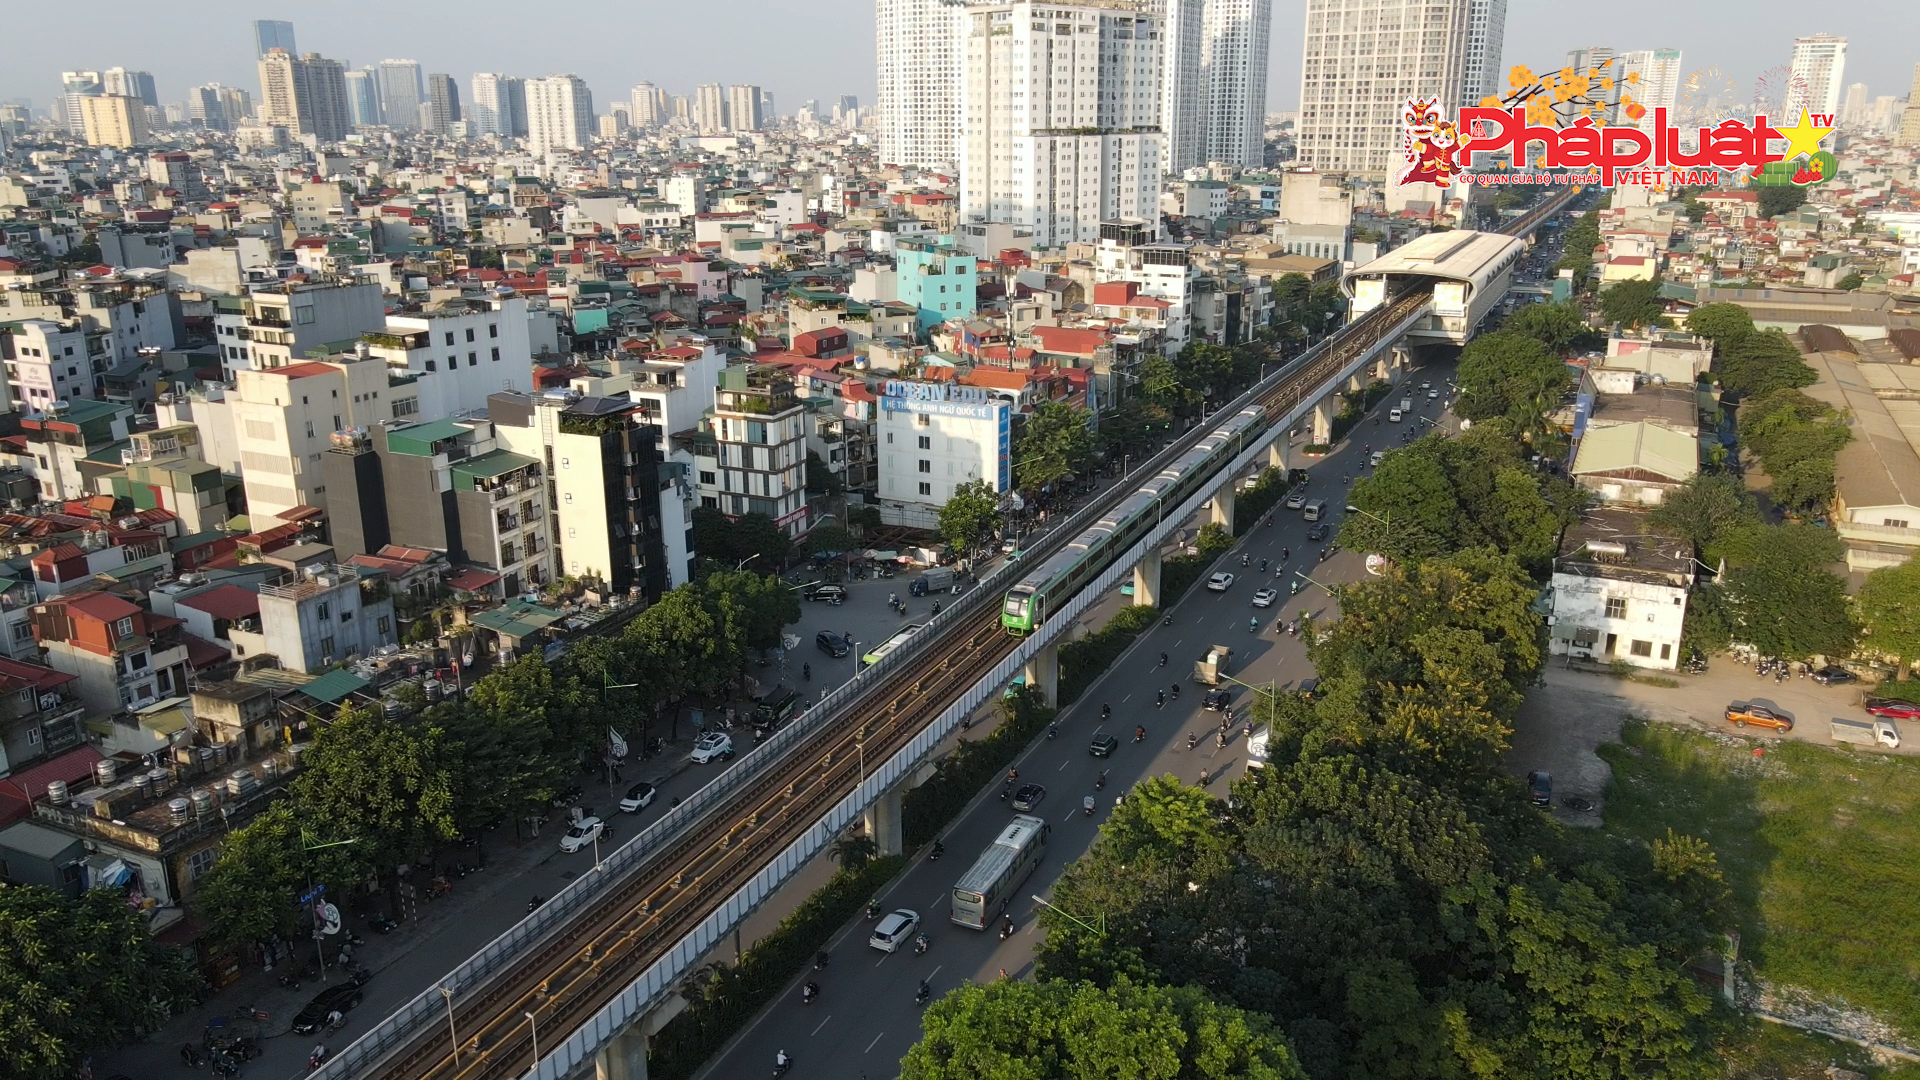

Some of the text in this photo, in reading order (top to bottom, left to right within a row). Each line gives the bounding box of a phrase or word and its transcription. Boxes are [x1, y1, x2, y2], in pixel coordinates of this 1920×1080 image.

[886, 380, 988, 405] OCEAN EDU
[886, 399, 987, 417] HỆ THỐNG ANH NGỮ QUỐC TẾ
